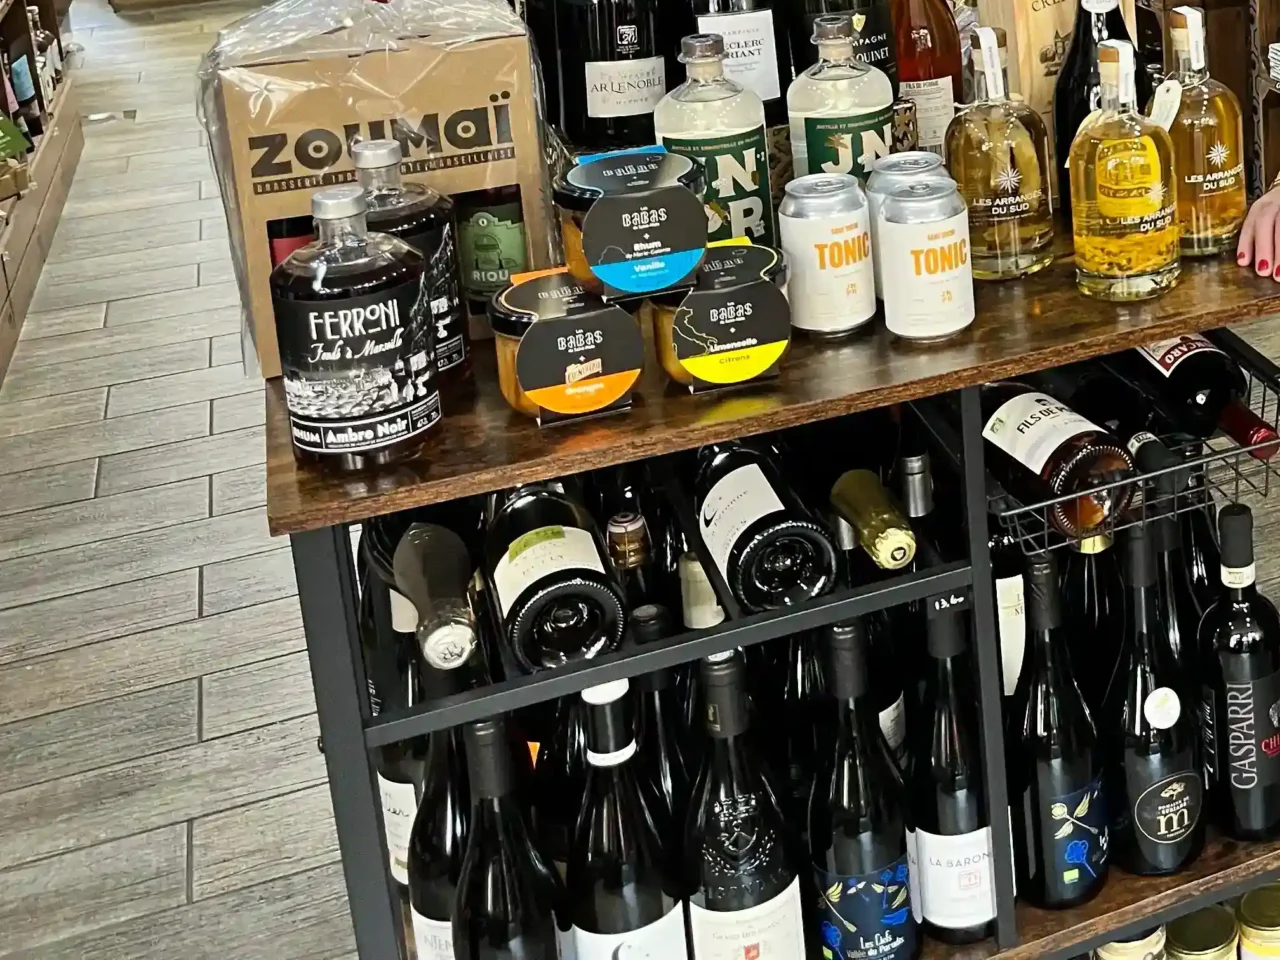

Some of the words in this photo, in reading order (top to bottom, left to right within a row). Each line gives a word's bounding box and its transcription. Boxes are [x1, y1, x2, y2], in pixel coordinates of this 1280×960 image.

[724, 38, 765, 51] ECLERC
[852, 32, 887, 47] MPAGNE
[728, 48, 763, 59] RIANT
[256, 175, 325, 194] BRASSERIE
[1184, 174, 1204, 184] LES
[1203, 181, 1217, 191] DU
[1218, 177, 1236, 189] SUD
[973, 196, 993, 208] LES
[992, 205, 1007, 215] DU
[1008, 202, 1030, 214] SUD
[1120, 215, 1141, 226] LES
[1140, 222, 1155, 233] DU
[1155, 216, 1173, 230] SUD
[633, 240, 662, 252] Rhum
[814, 231, 870, 271] TONIC
[910, 238, 967, 276] TONIC
[633, 260, 666, 273] Vanille
[473, 269, 509, 282] RIOU
[309, 298, 401, 340] FERRONI
[719, 353, 751, 364] Citrons
[377, 418, 408, 436] Noir
[1016, 413, 1042, 434] FILS
[1039, 406, 1058, 417] DE
[1226, 681, 1258, 789] GASPARRI
[929, 856, 942, 867] LA
[946, 852, 991, 868] BARON
[860, 936, 874, 950] Les
